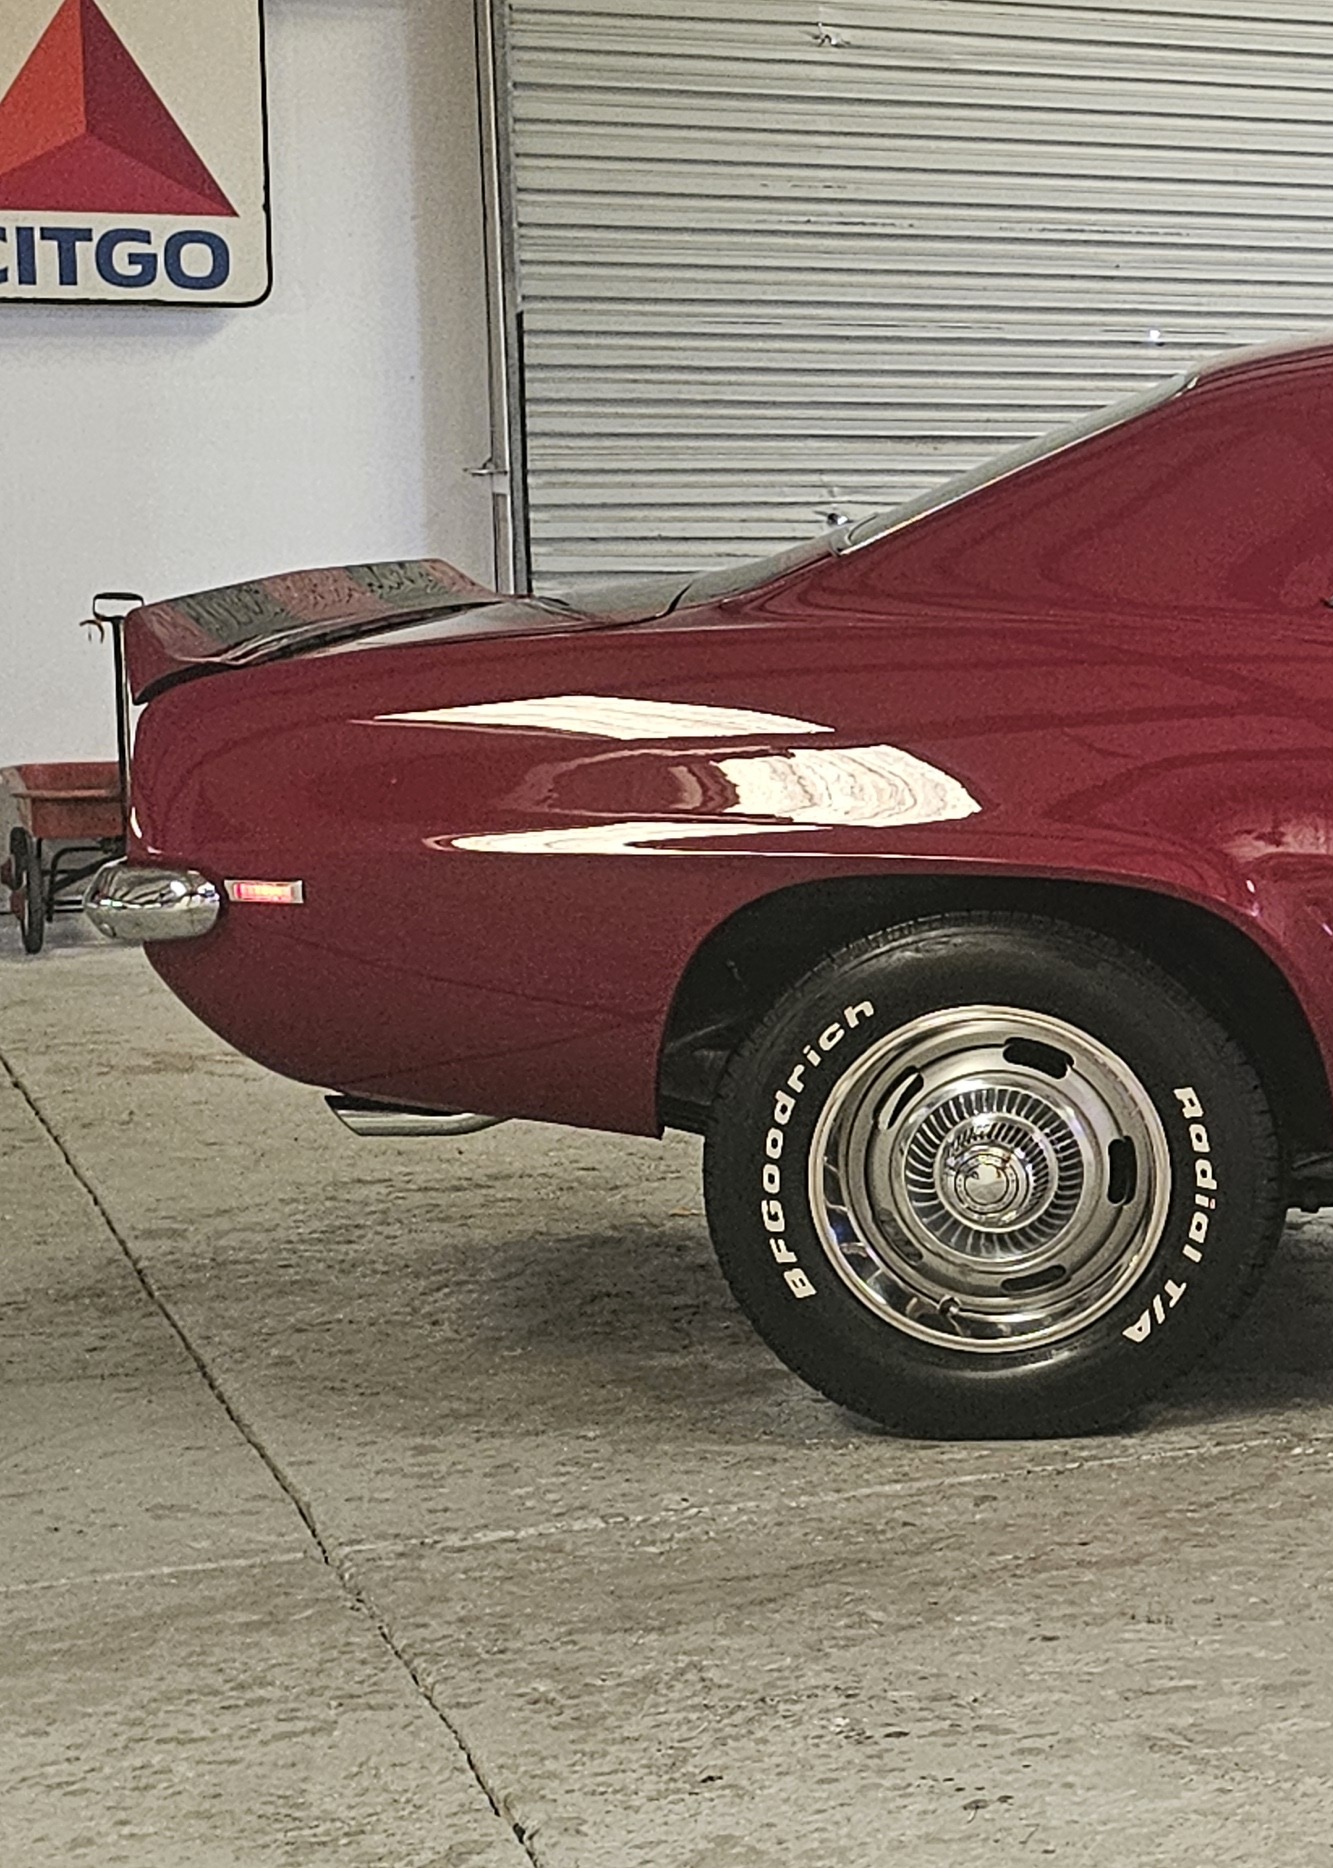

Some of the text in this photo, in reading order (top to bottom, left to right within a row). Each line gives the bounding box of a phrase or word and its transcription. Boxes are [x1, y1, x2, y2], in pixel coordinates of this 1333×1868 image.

[0, 226, 231, 290] ITGO
[761, 1000, 876, 1300] BFGoodrich
[1121, 1085, 1218, 1343] Radial T/A
